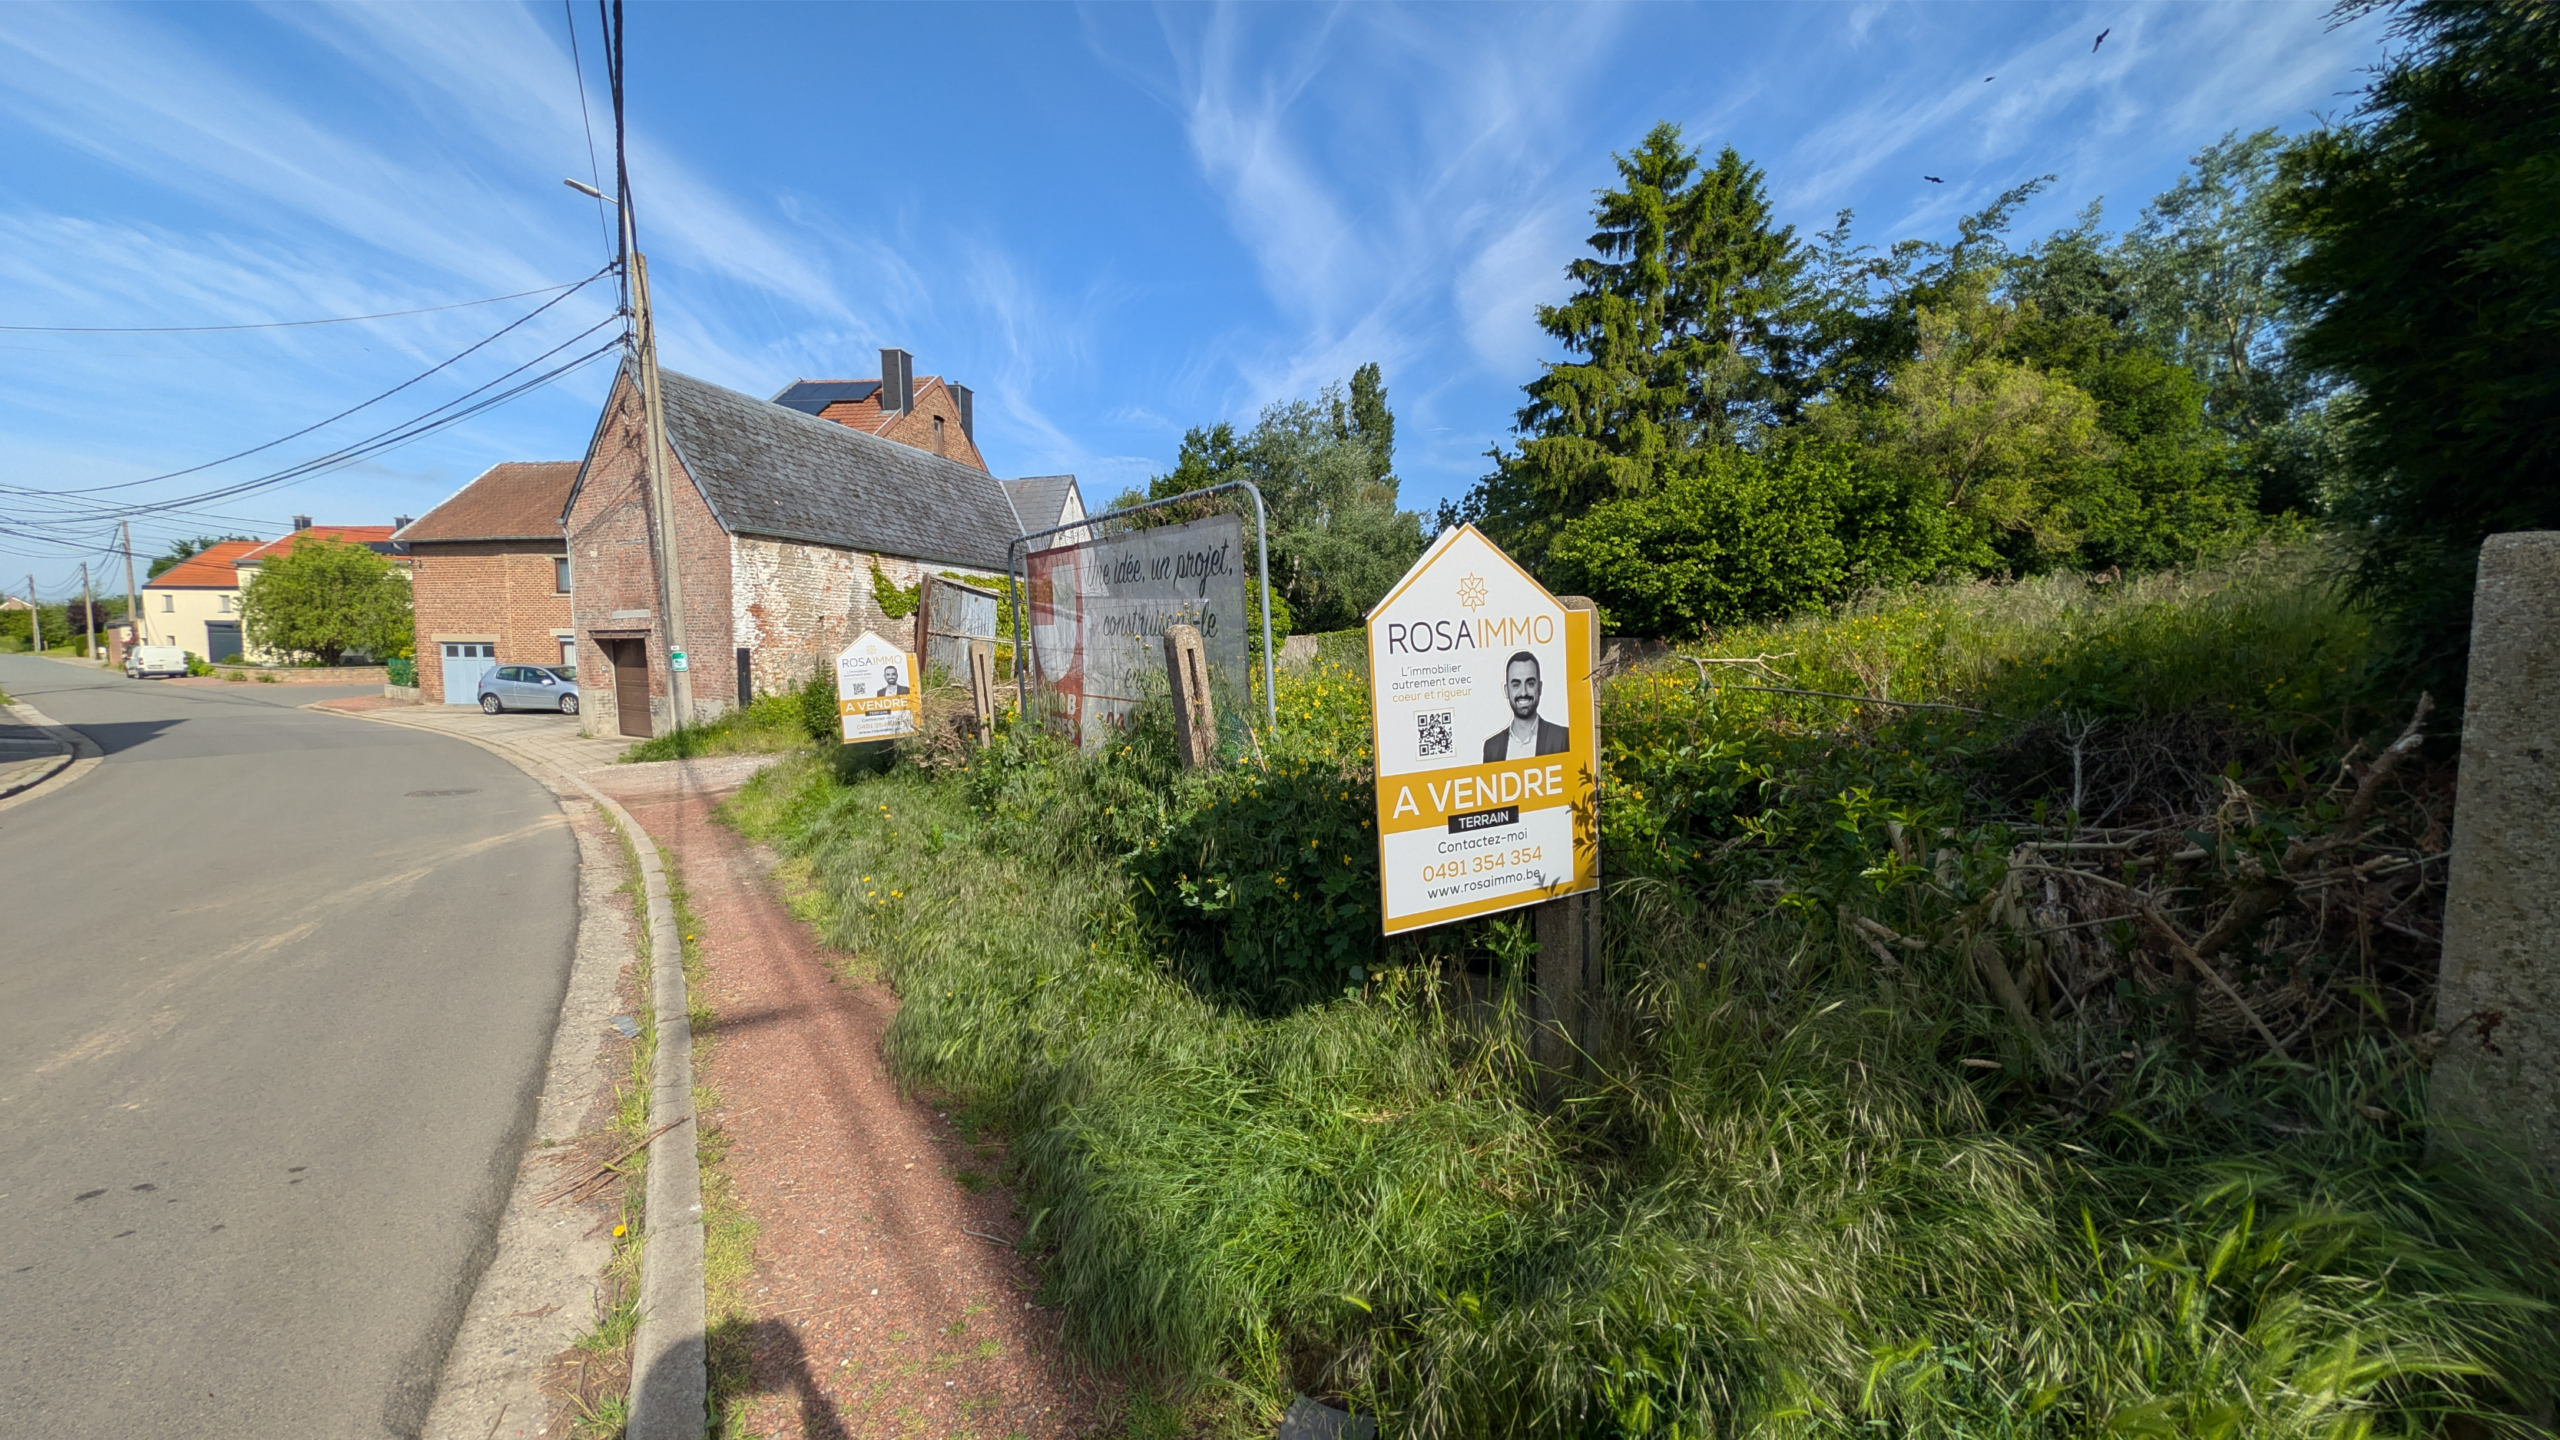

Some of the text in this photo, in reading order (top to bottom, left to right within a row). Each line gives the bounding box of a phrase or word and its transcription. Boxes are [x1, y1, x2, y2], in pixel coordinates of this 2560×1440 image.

[1086, 537, 1233, 599] Une idée, un projet,
[1388, 615, 1554, 655] ROSAIMMO
[842, 655, 902, 668] ROSAIMMO
[1401, 663, 1462, 677] L'immobilier
[1392, 676, 1472, 690] autrement avec
[846, 698, 908, 712] A VENDRE
[1392, 688, 1472, 703] coeur et rigueur
[1393, 764, 1563, 819] A VENDRE
[1458, 810, 1509, 829] TERRAIN
[1438, 828, 1528, 854] Contactez-moi
[1423, 845, 1542, 882] 0491 354 354
[1427, 868, 1540, 899] www.rosaimmo.be
